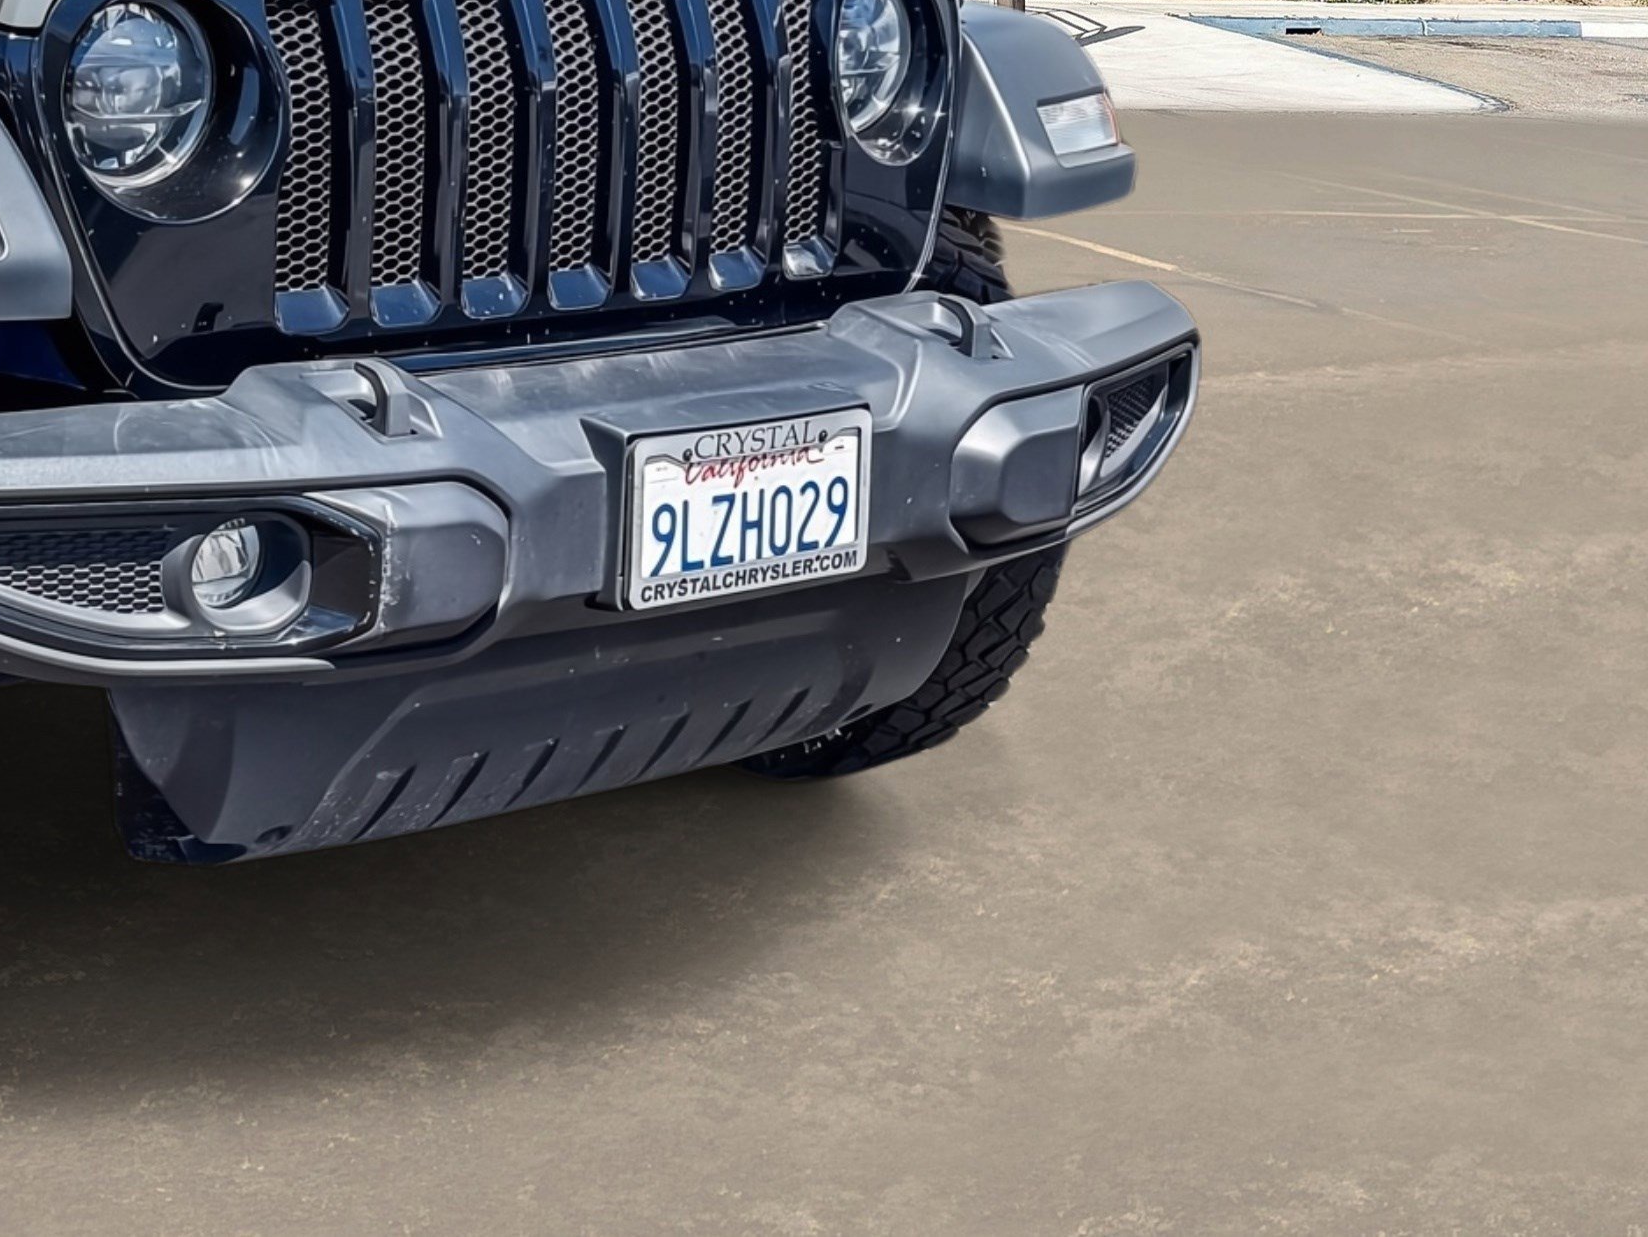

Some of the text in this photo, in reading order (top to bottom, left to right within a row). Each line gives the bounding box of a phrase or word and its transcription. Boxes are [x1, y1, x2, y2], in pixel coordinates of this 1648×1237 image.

[693, 420, 816, 460] CRYSTAL
[650, 475, 849, 578] 9LZH029
[640, 550, 858, 603] CRYSTALCHRYSLER.COM
